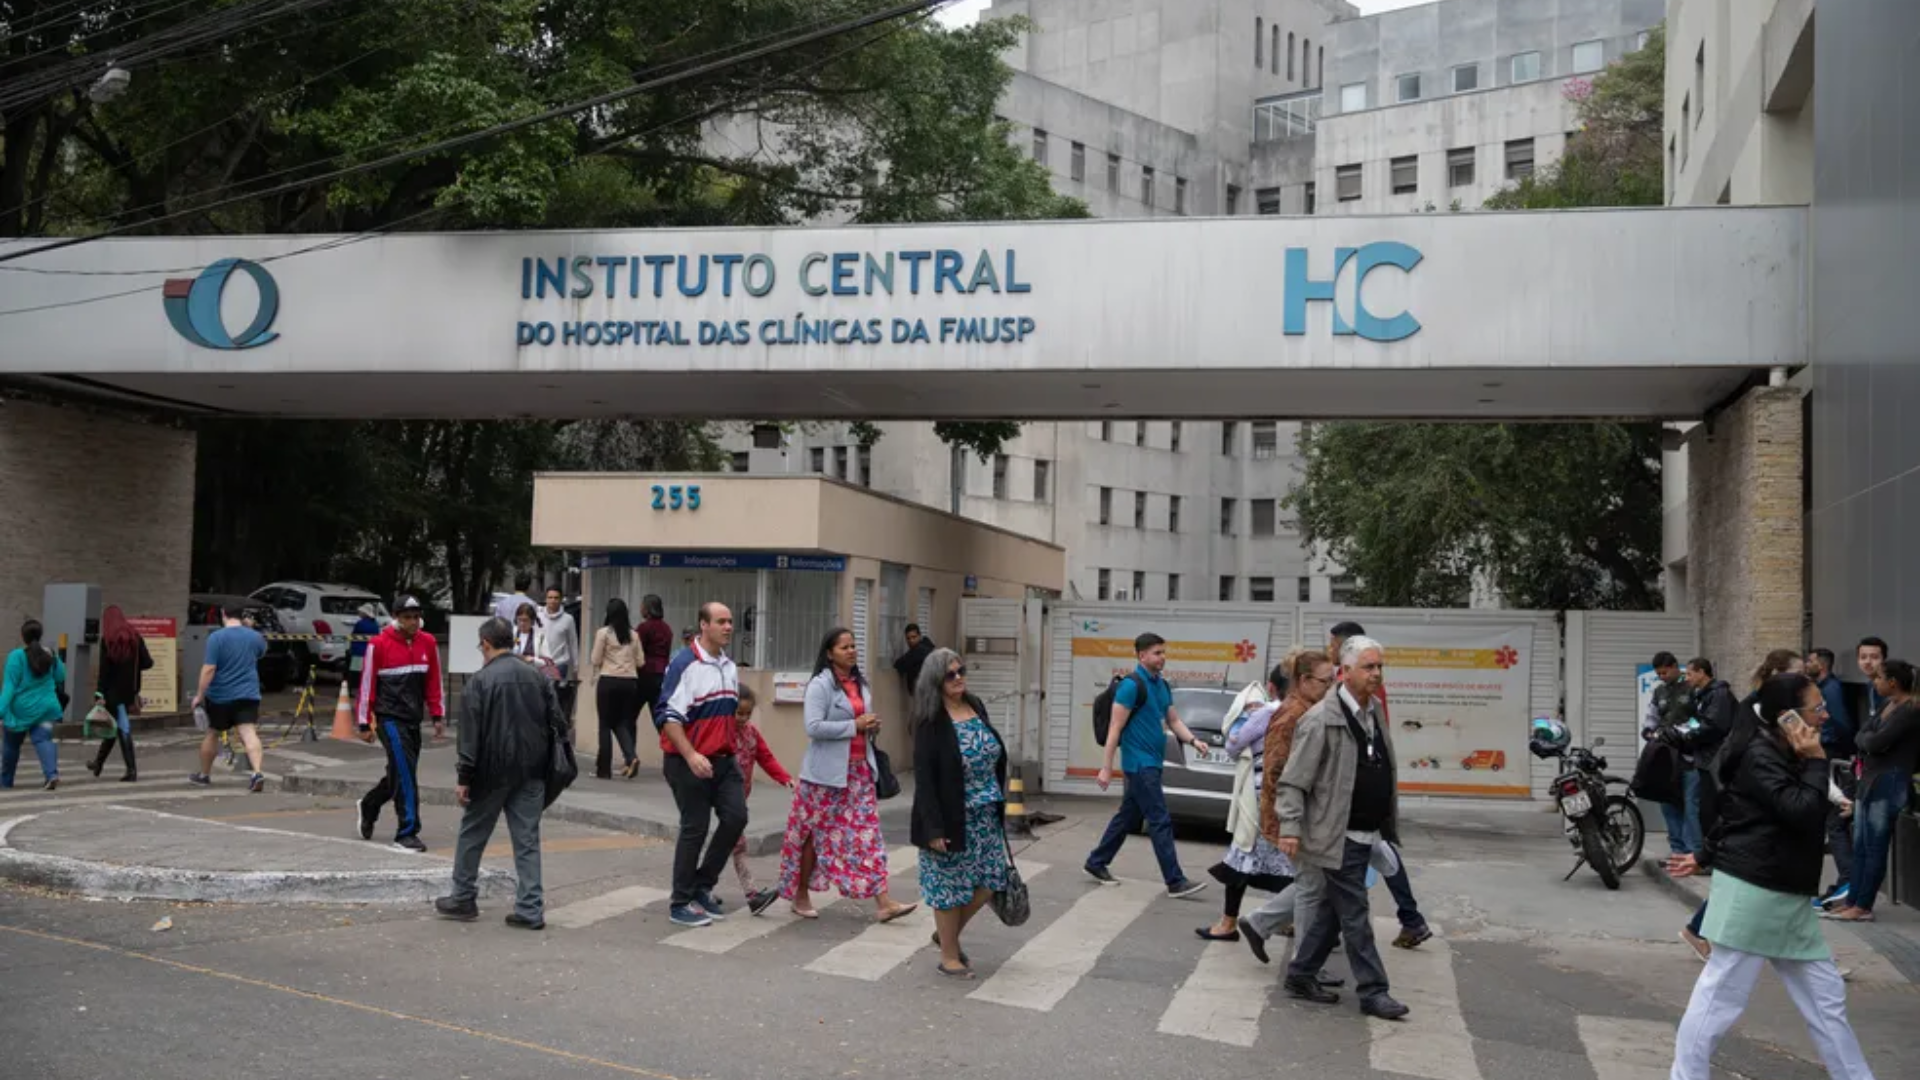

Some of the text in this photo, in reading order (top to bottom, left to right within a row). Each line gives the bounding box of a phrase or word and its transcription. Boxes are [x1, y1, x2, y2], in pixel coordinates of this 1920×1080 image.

[522, 249, 1032, 299] INSTITUTO CENTRAL
[1283, 240, 1425, 343] HC
[516, 312, 1036, 346] DO HOSPITAL DAS CLÍNICAS DA FMUSP
[651, 484, 701, 511] 255
